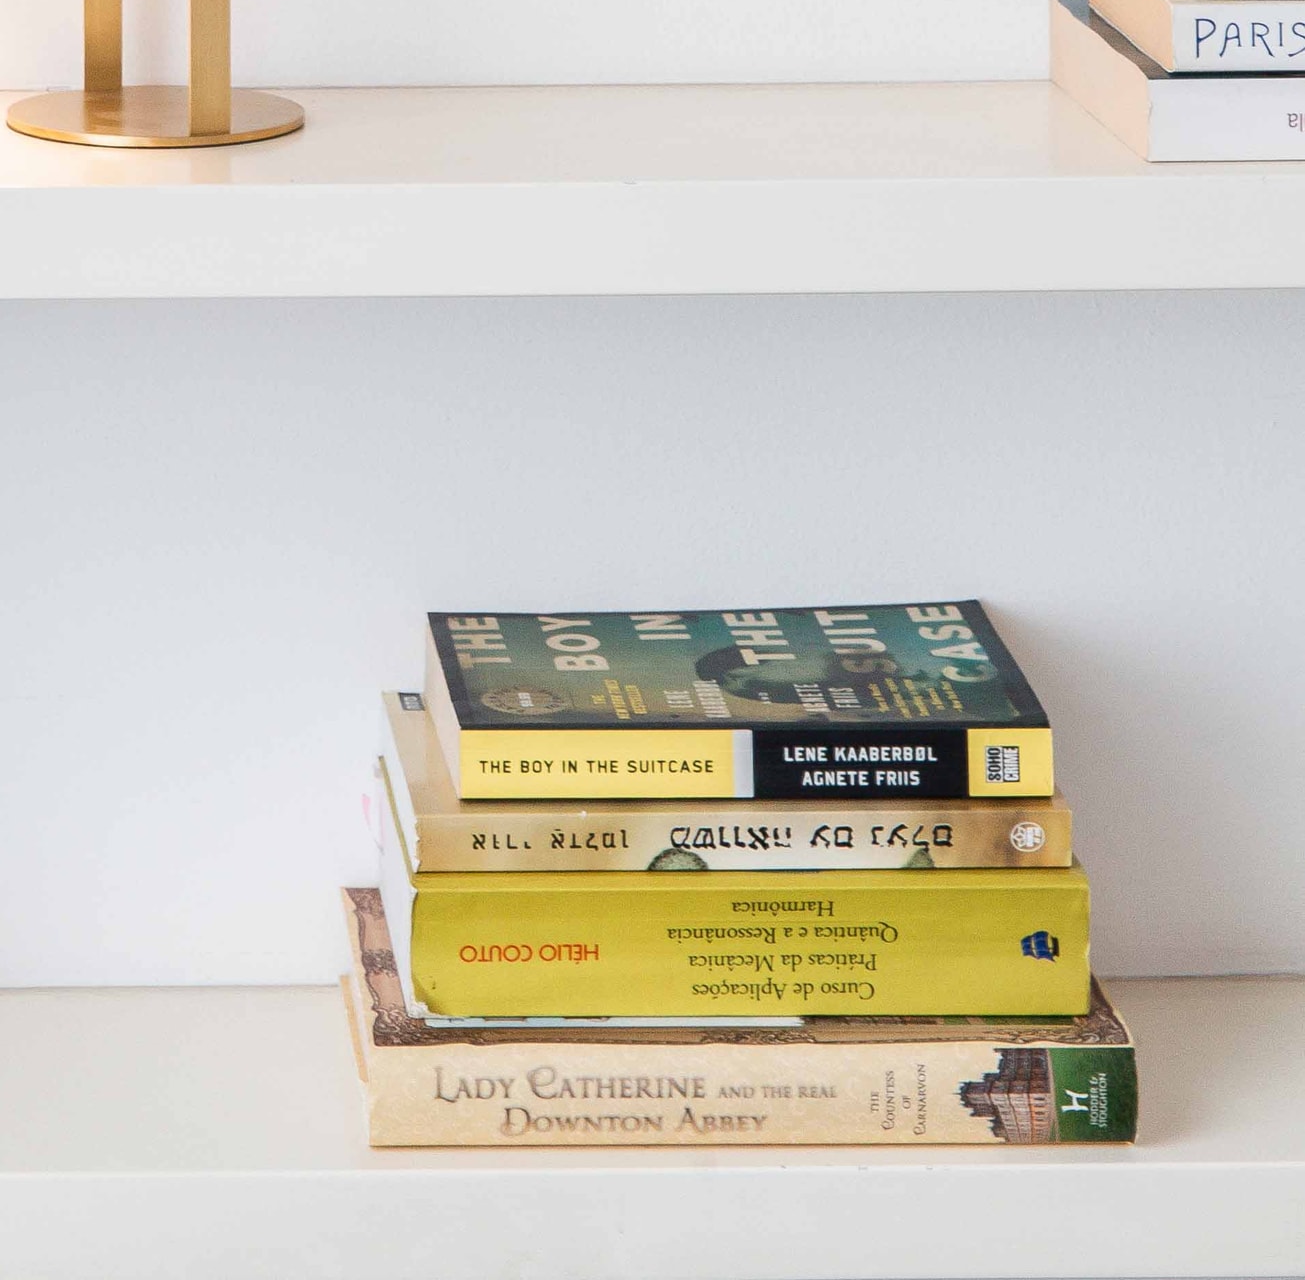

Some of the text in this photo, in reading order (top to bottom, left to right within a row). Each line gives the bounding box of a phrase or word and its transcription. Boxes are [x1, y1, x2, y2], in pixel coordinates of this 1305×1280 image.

[630, 614, 692, 641] IN
[722, 611, 796, 666] THE
[448, 616, 512, 669] THE
[537, 616, 611, 671] BOY
[905, 604, 997, 683] CASE
[793, 682, 831, 712] AGNETE
[828, 686, 863, 708] FRIIS
[479, 759, 714, 773] THE BOY IN THE SUITCASE
[783, 746, 938, 762] LENE KAABERBØL
[986, 747, 1001, 782] SOHO
[1003, 746, 1020, 782] CRIME
[802, 771, 921, 786] AGNETE FRIIS
[670, 825, 792, 851] משוואה
[811, 823, 854, 850] עם
[871, 824, 954, 851] נעלם
[731, 900, 835, 917] Harmônica
[667, 921, 898, 943] Quântica e a Ressonância
[459, 943, 599, 965] HÉLIO COUTO
[688, 952, 877, 972] Práticas da Mecânica
[692, 981, 875, 1001] Curso de Aplicações
[433, 1066, 837, 1103] LADY CATHERINE AND THE REAL
[871, 1091, 880, 1113] THE
[882, 1070, 895, 1131] COUNTESS
[903, 1095, 912, 1109] OF
[913, 1063, 926, 1136] CARNARVON
[1089, 1087, 1099, 1126] HODDER
[1098, 1072, 1108, 1128] STOUGHTON
[500, 1107, 768, 1137] DOWNTON ABBEY
